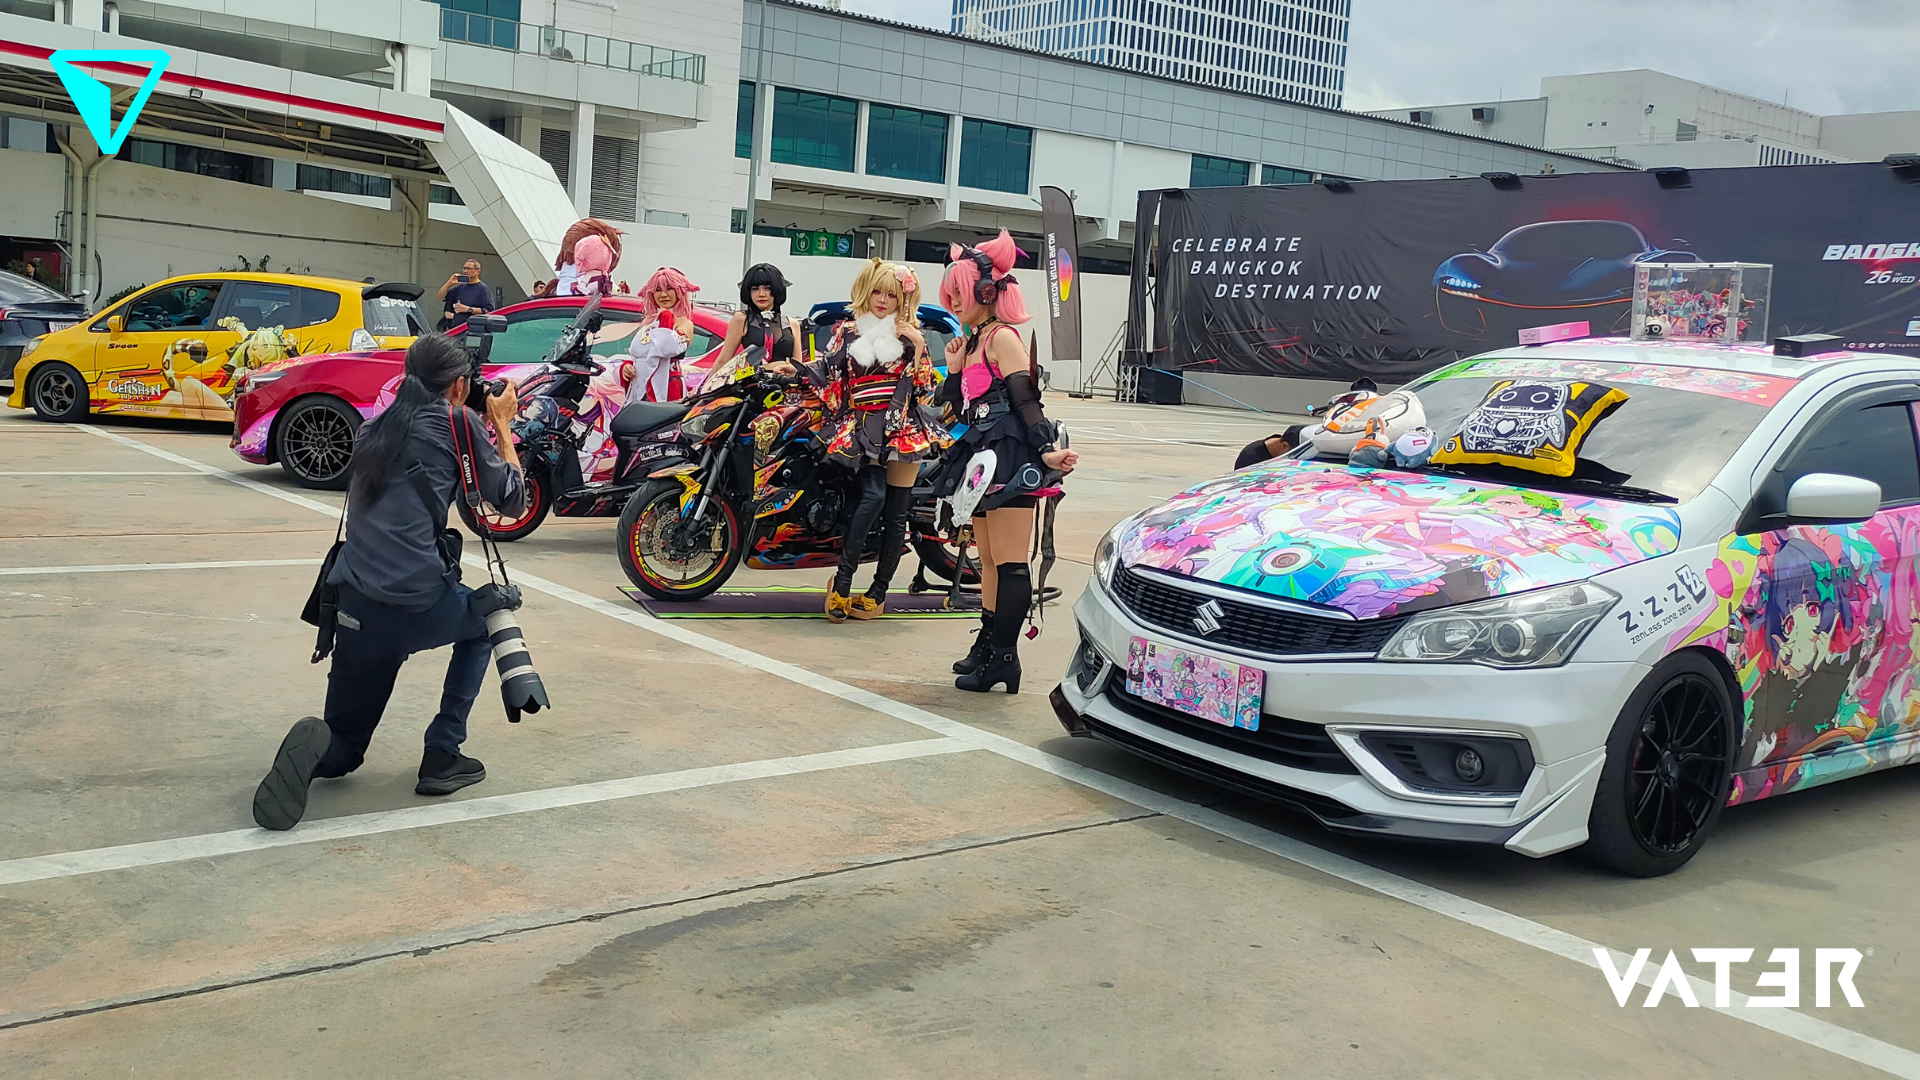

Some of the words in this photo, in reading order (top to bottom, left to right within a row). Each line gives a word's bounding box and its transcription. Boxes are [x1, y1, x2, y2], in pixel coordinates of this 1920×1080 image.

[1172, 237, 1302, 253] CELEBRATE
[1190, 260, 1303, 276] BANGKOK
[1864, 270, 1893, 284] 26
[1892, 276, 1916, 284] WED
[1215, 284, 1382, 300] DESTINATION
[108, 379, 162, 397] GENSHIN
[462, 453, 473, 484] Canon
